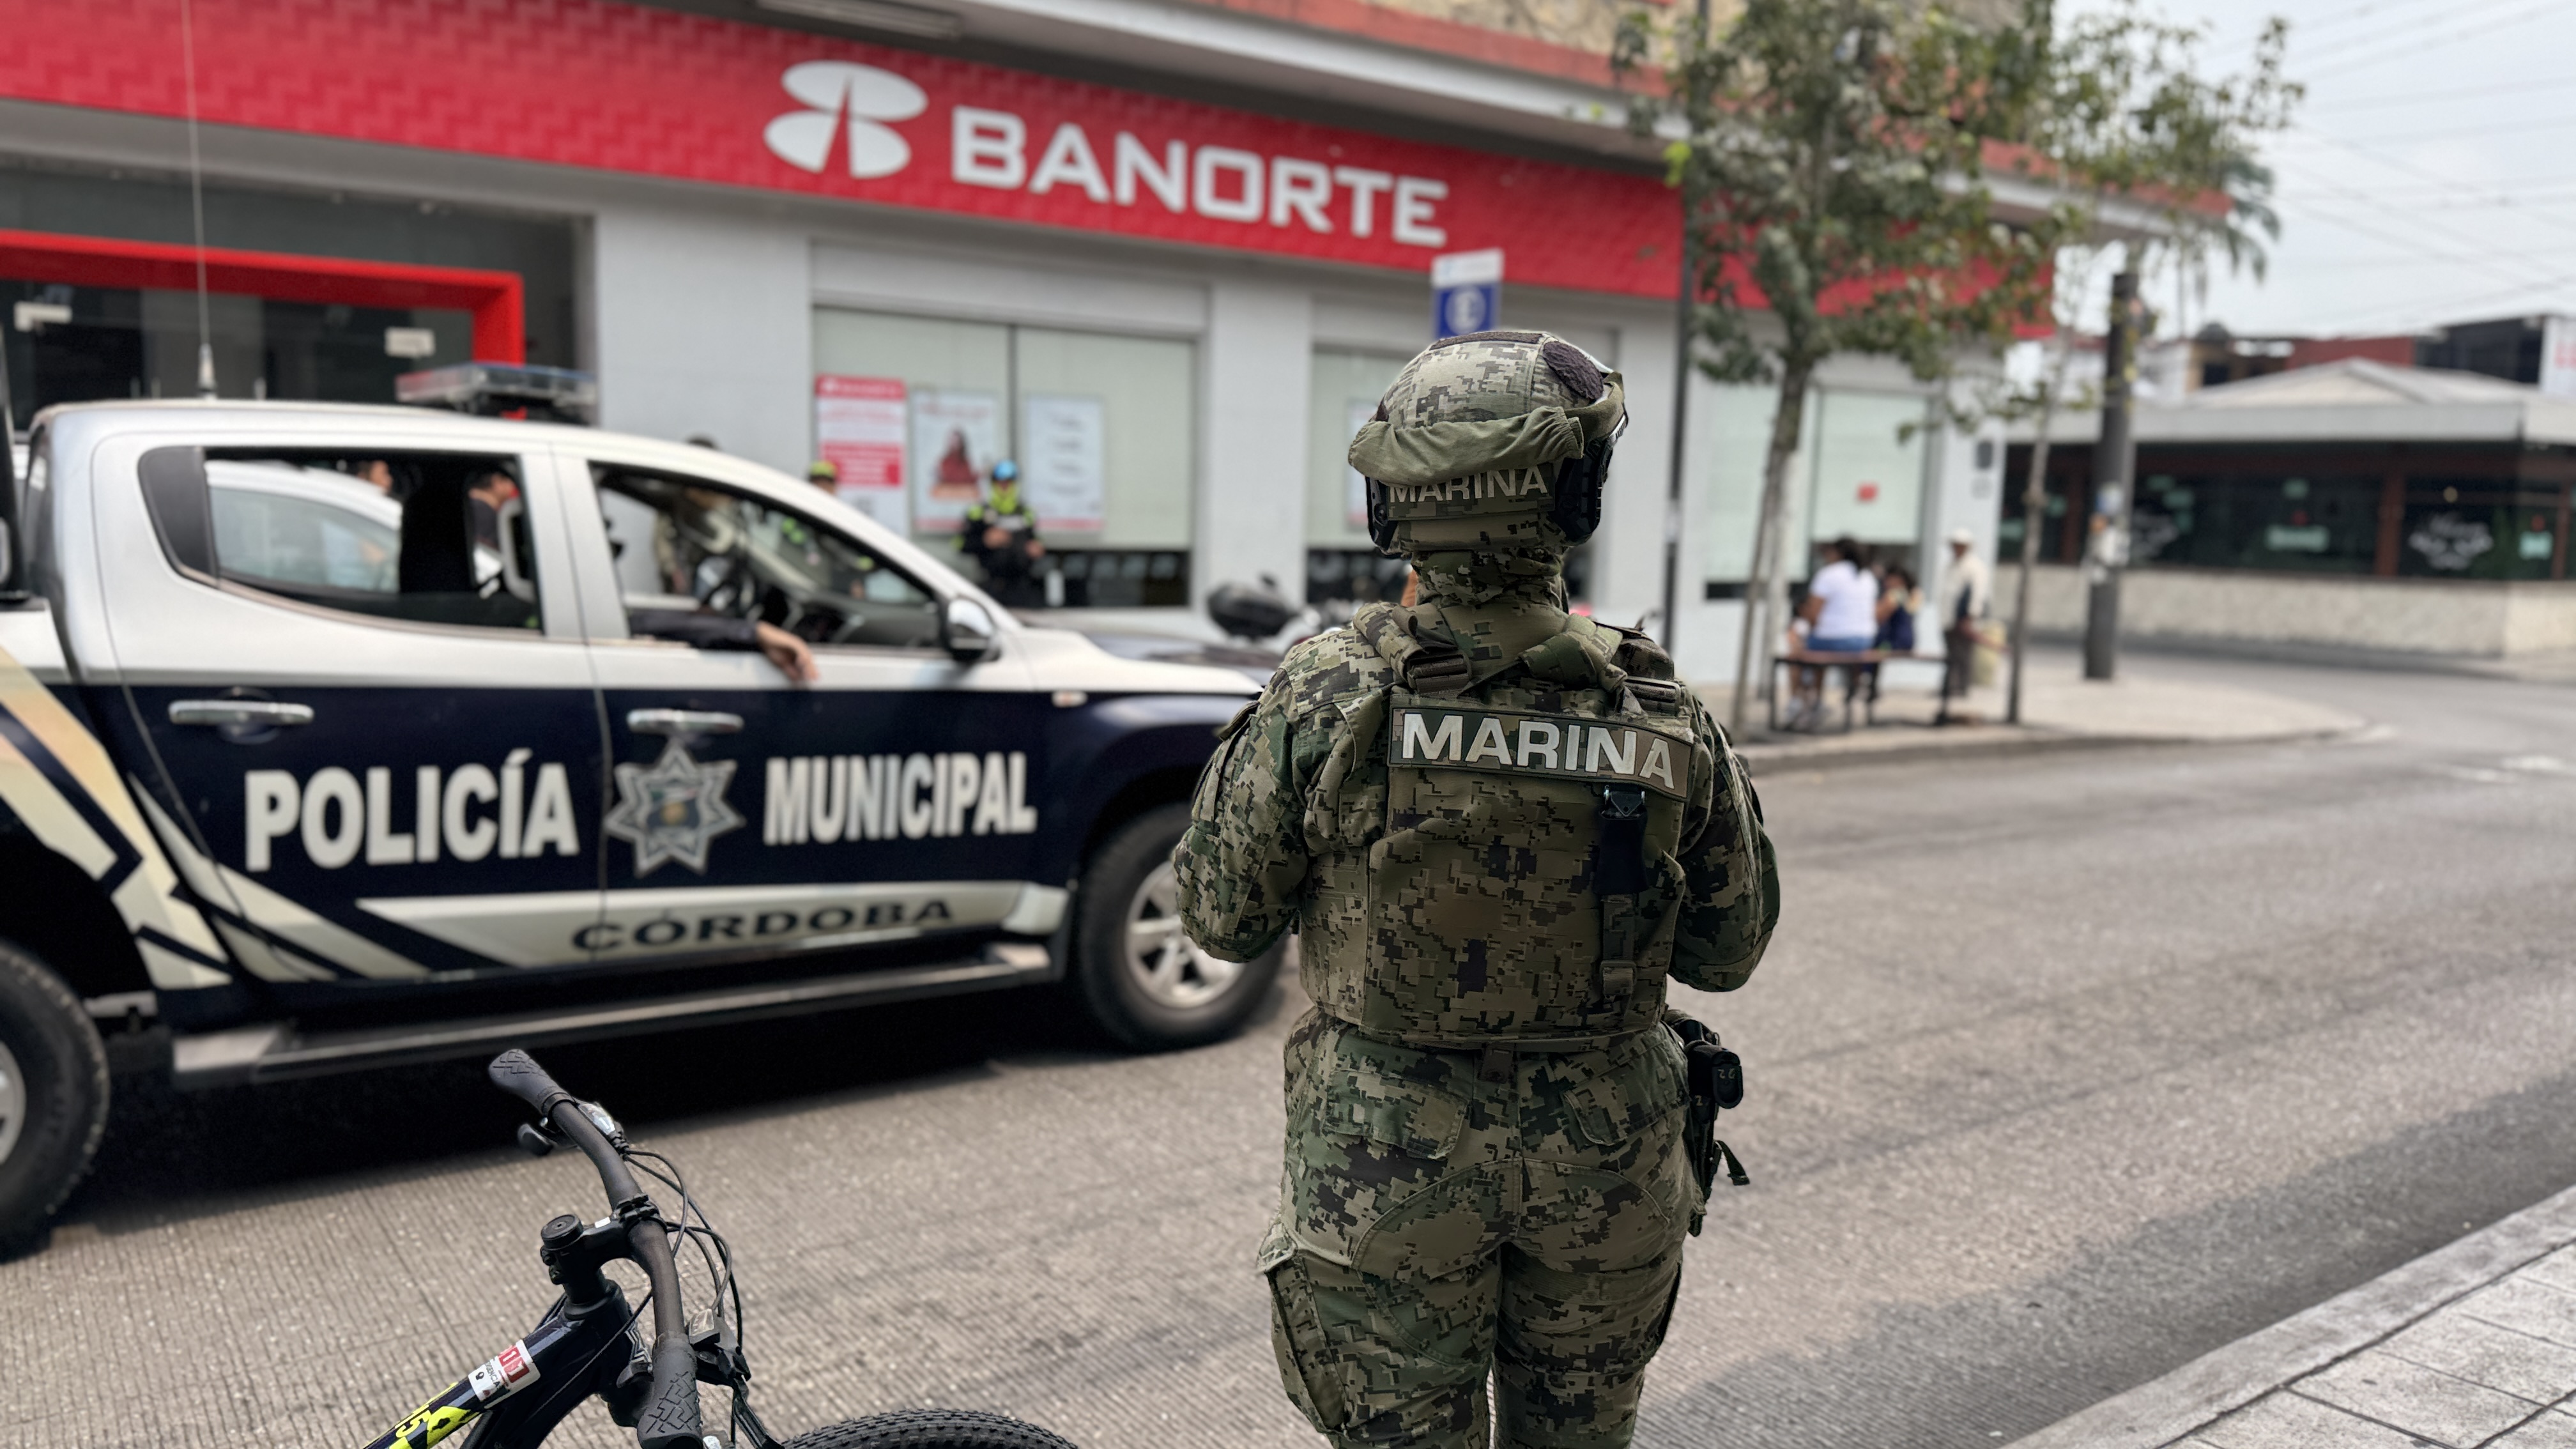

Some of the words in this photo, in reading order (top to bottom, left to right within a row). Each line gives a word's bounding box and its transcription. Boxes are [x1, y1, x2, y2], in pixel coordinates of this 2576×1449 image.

[951, 105, 1448, 247] BANORTE
[1390, 466, 1547, 503] MARINA
[1402, 713, 1675, 790] MARINA
[245, 747, 580, 871] POLICÍA
[763, 751, 1038, 846] MUNICIPAL
[571, 900, 953, 953] CÓRDOBA
